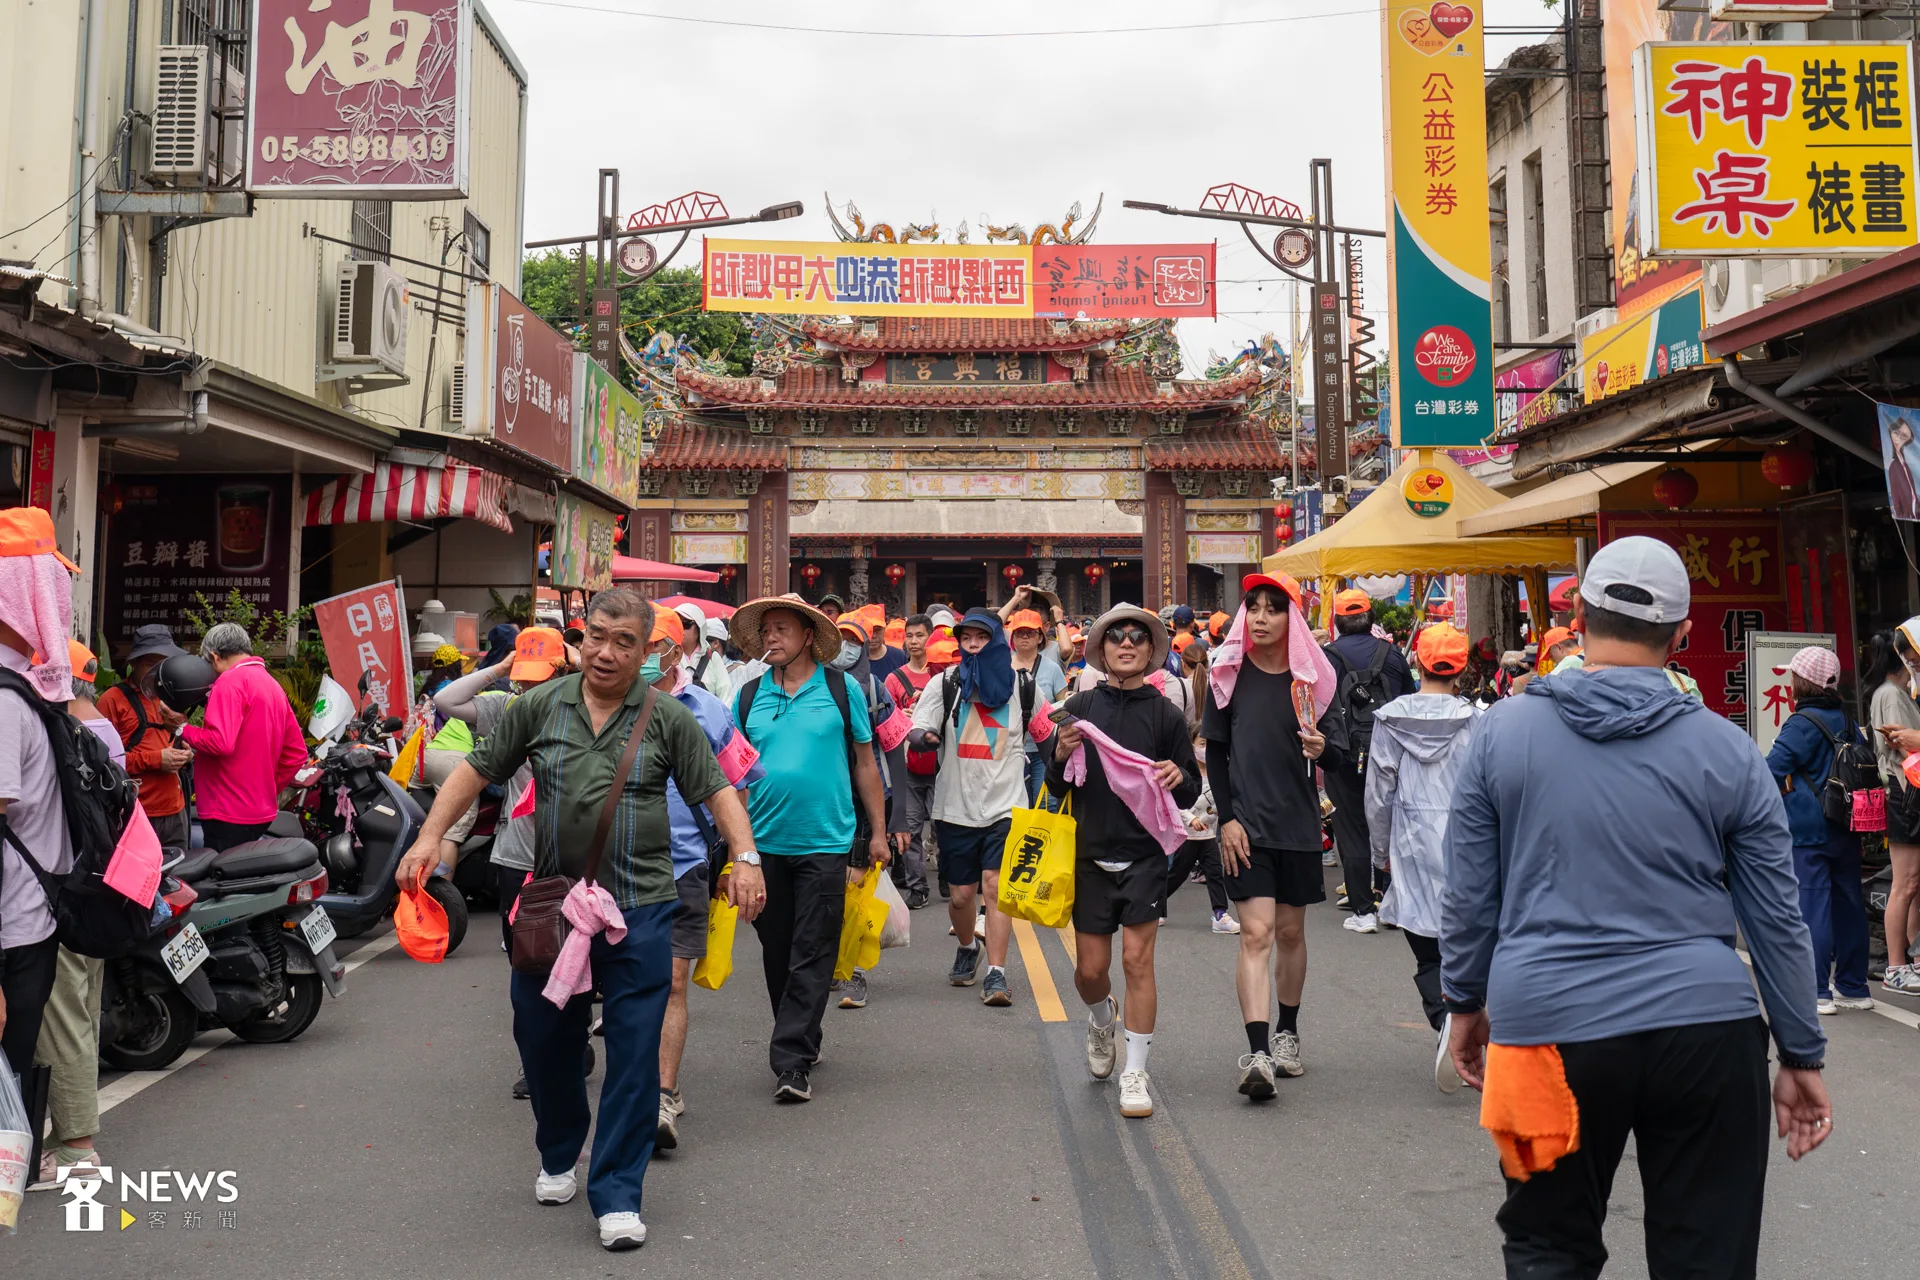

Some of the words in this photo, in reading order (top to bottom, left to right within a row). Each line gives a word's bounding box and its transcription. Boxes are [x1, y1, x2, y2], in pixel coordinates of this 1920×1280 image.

[1802, 58, 1903, 132] 裝框
[1422, 72, 1458, 216] 公益彩券
[1662, 57, 1797, 236] 神桌
[1806, 161, 1908, 234] 裱畫
[1322, 313, 1338, 386] 西螺媽祖
[1424, 332, 1455, 347] We
[1443, 344, 1461, 355] are
[1415, 345, 1476, 374] Family
[1670, 344, 1700, 369] 台灣彩券
[1609, 363, 1638, 391] 公益彩券
[1414, 399, 1480, 415] 台灣彩券
